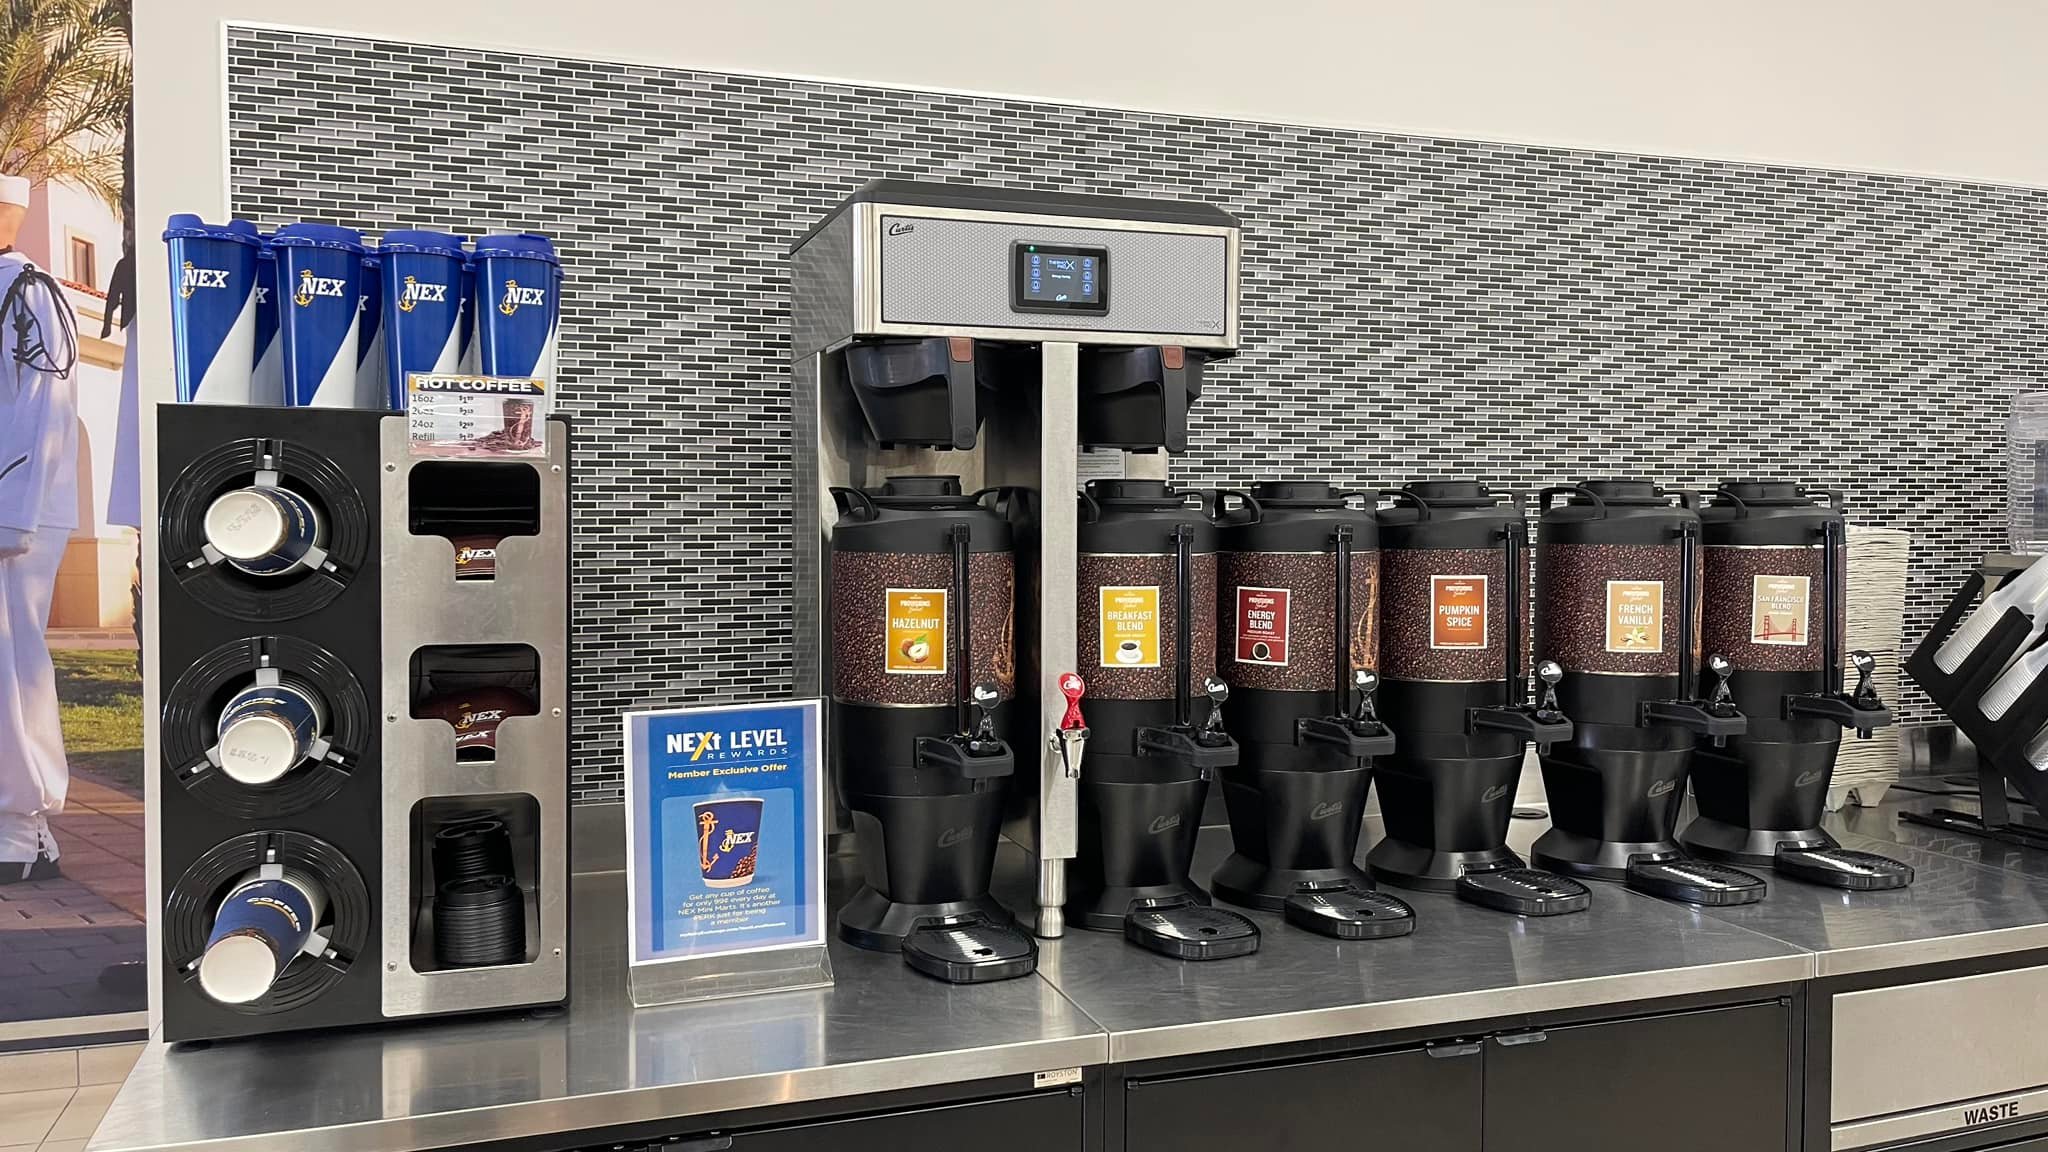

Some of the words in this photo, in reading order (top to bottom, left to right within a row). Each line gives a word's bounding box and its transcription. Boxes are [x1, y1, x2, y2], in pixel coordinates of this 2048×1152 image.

[182, 269, 230, 288] NEX
[300, 277, 346, 297] NEX
[405, 283, 448, 302] NEX
[506, 287, 545, 306] NEX
[416, 377, 455, 390] HOT
[459, 379, 532, 392] COFFEE
[412, 395, 434, 403] 16oz
[412, 420, 434, 428] 24oz
[412, 432, 435, 440] Refill
[462, 549, 497, 559] NEX
[1439, 605, 1479, 615] PUMPKIN
[1618, 604, 1653, 614] FRENCH
[1107, 611, 1152, 621] BREAKFAST
[1247, 610, 1275, 621] ENERGY
[1618, 615, 1653, 625] VANILLA
[892, 618, 940, 629] HAZELNUT
[1117, 621, 1144, 631] BLEND
[1249, 620, 1273, 630] BLEND
[1446, 617, 1472, 627] SPICE
[462, 710, 503, 724] NEX
[730, 729, 788, 749] LEVEL
[707, 747, 788, 760] REWARDS
[668, 769, 710, 780] Member
[713, 765, 759, 776] Exclusive
[761, 763, 788, 773] Offer
[725, 831, 755, 846] NEX
[678, 908, 696, 916] NEX
[1046, 1068, 1078, 1079] ROYSTON
[1964, 1101, 2019, 1125] WASTE
